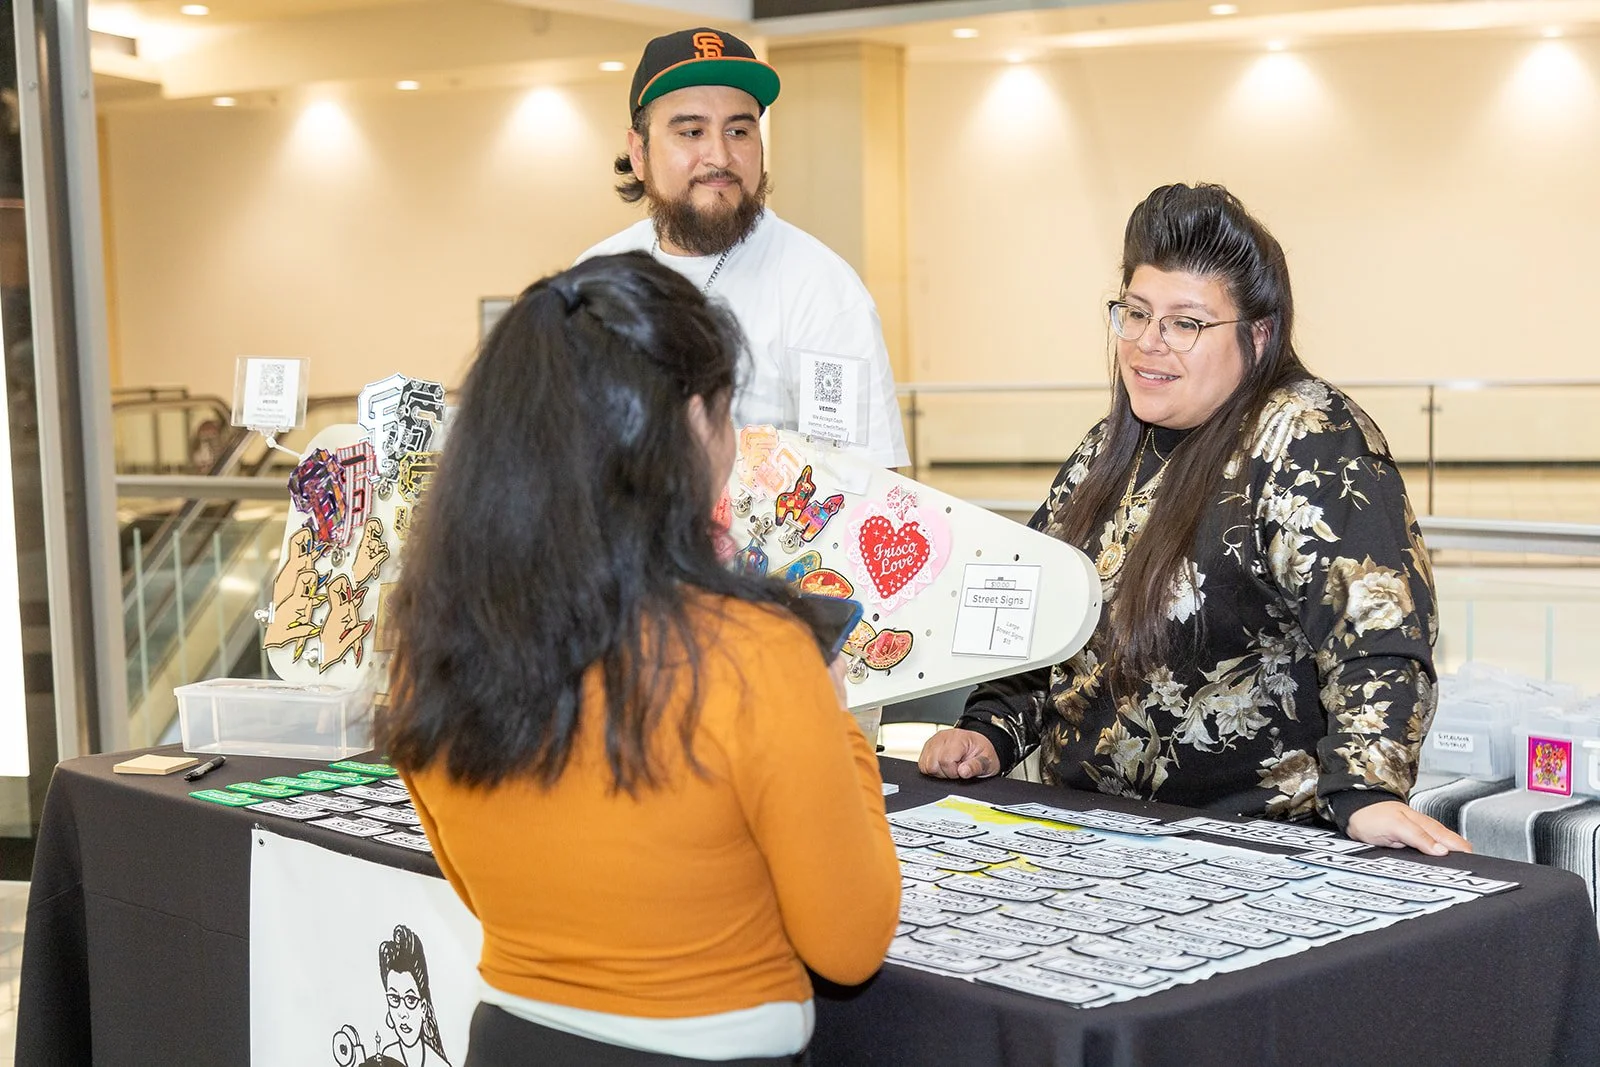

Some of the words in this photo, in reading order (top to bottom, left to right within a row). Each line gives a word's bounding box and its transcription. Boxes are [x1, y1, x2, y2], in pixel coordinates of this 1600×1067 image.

[873, 541, 917, 561] Frisco
[880, 555, 915, 577] Love
[972, 594, 998, 604] Street
[1000, 595, 1025, 607] Signs
[1196, 821, 1336, 848] FRISCO
[1316, 855, 1488, 887] MISSION
